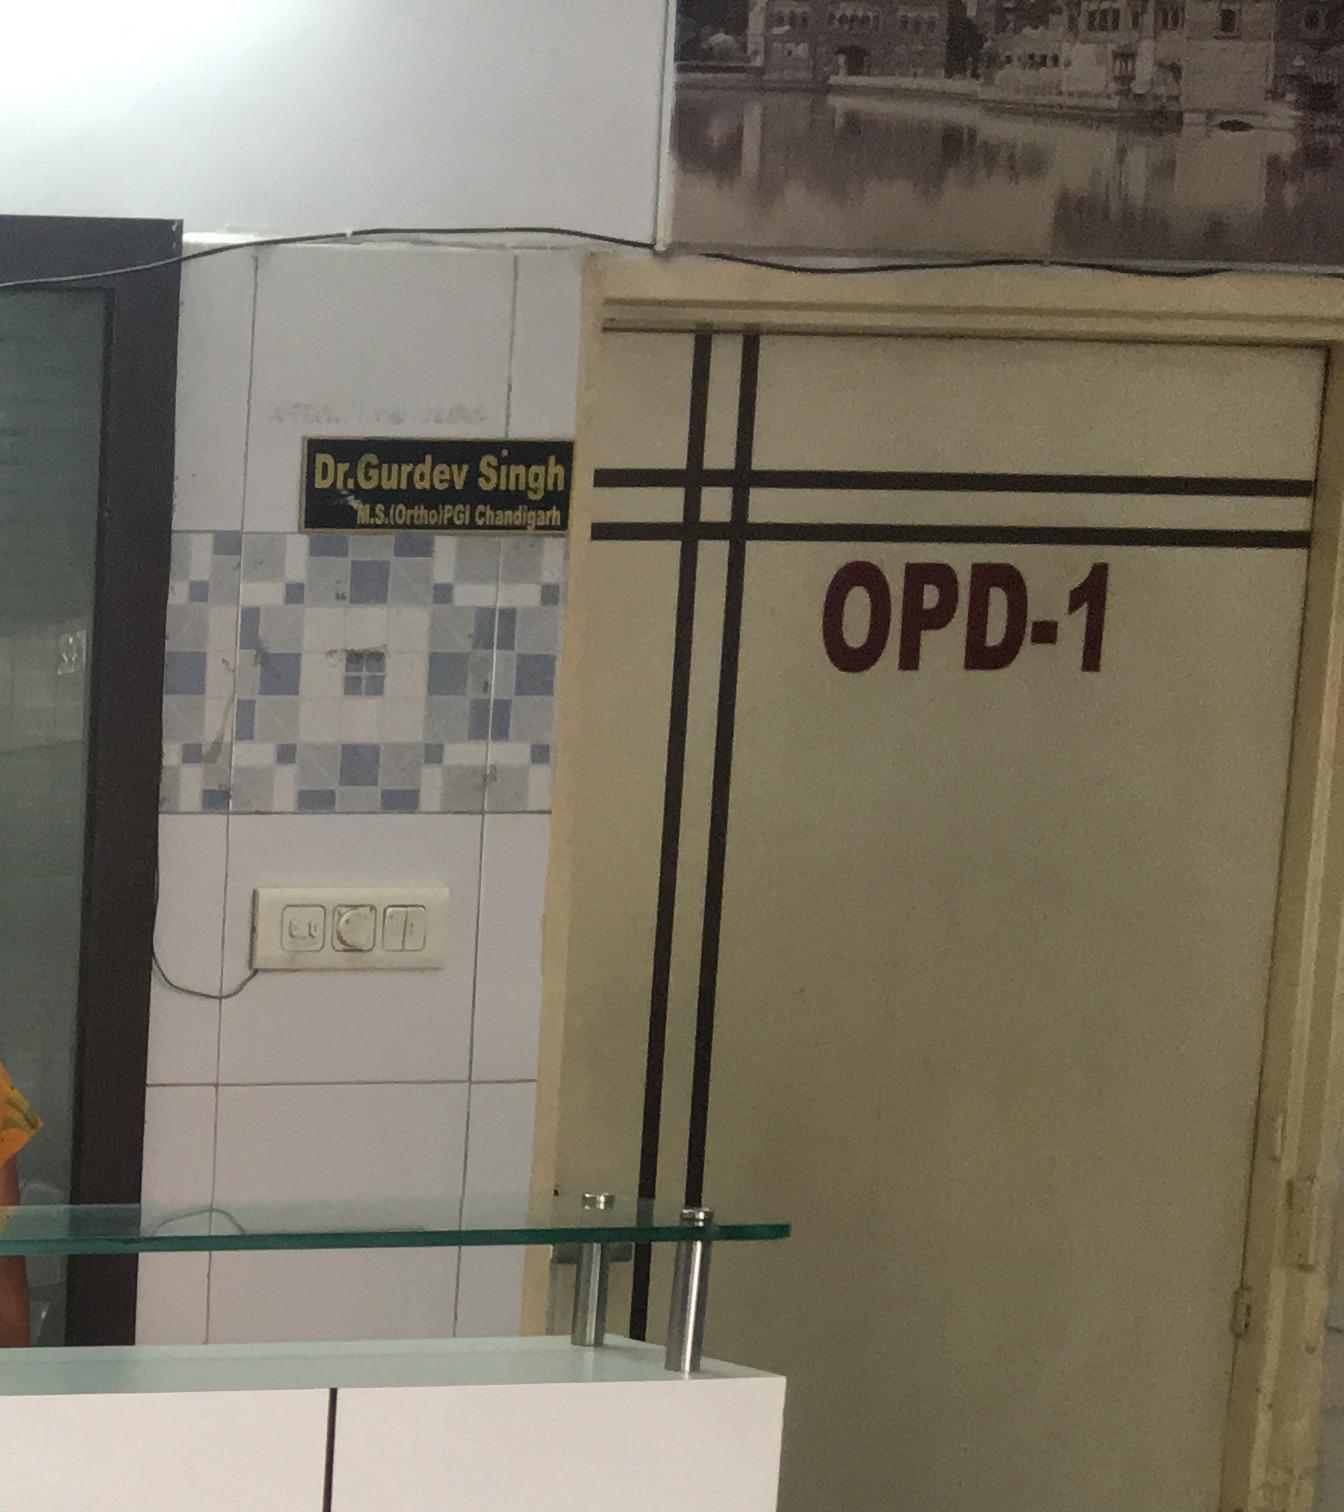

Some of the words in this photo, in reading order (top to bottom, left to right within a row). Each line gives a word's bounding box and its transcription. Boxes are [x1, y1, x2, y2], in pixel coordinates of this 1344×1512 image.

[477, 449, 566, 500] Singh
[474, 504, 561, 532] Chandigarh
[822, 560, 1109, 674] OPD-1
